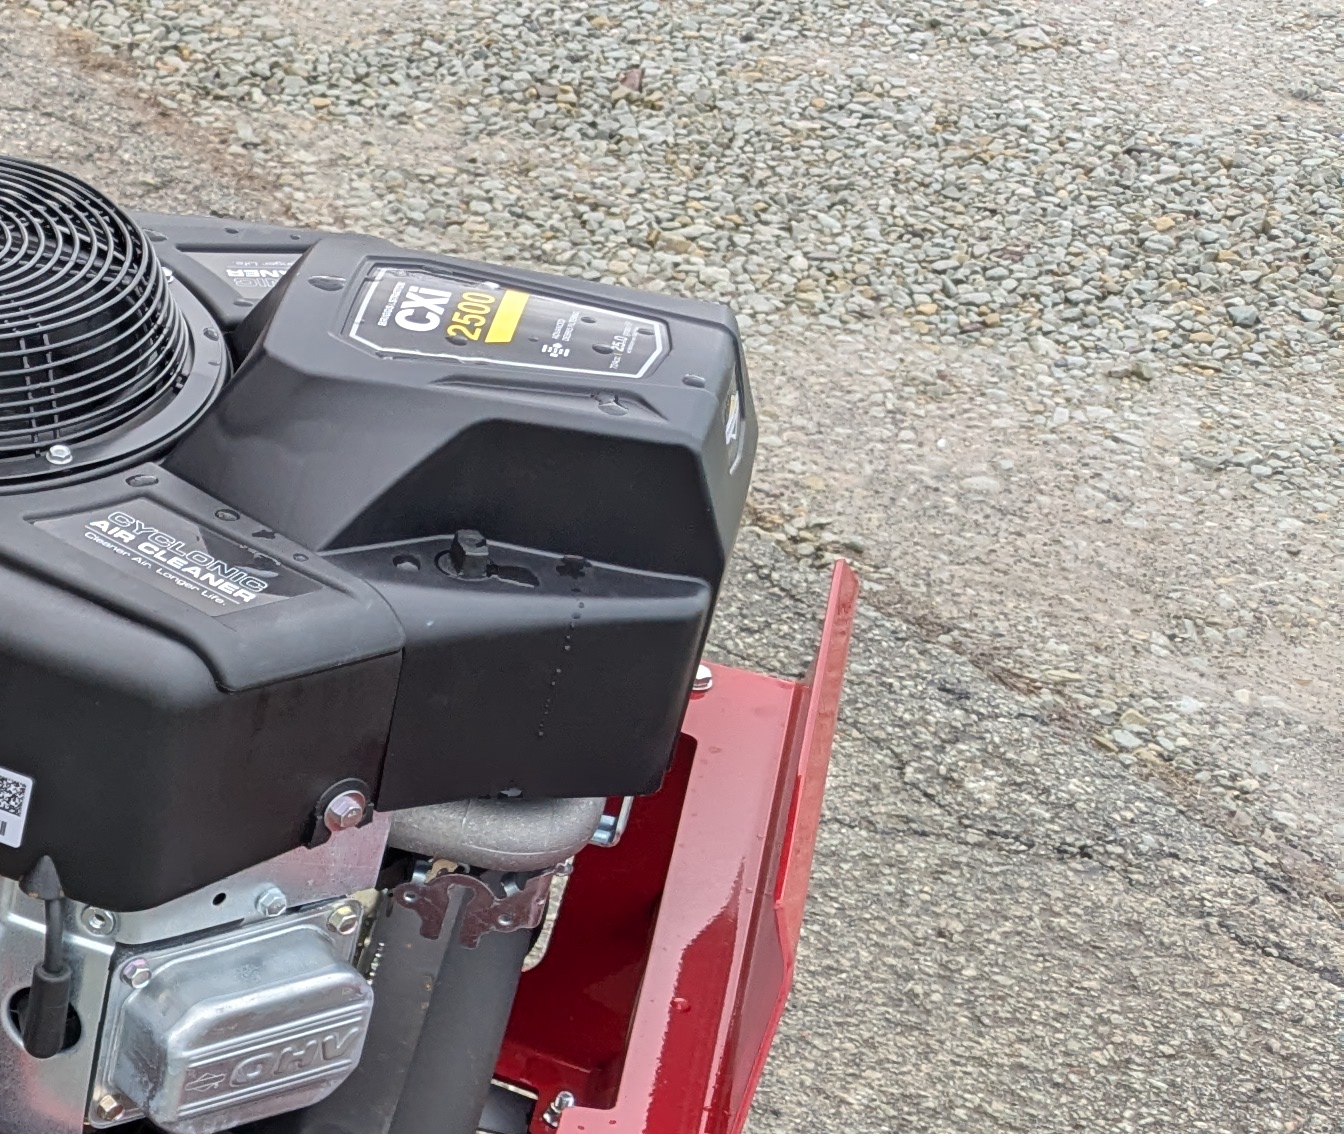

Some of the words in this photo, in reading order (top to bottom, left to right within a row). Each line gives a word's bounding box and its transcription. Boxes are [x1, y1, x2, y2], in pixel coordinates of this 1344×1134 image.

[395, 286, 452, 331] CXi
[446, 292, 496, 340] 2500
[84, 532, 131, 557] Cleaner
[156, 568, 200, 591] Longer
[201, 589, 225, 605] Life.
[90, 520, 135, 543] AIR
[137, 542, 256, 602] CLEANER
[108, 512, 268, 593] CYCLONIC
[229, 1026, 360, 1088] OHV
